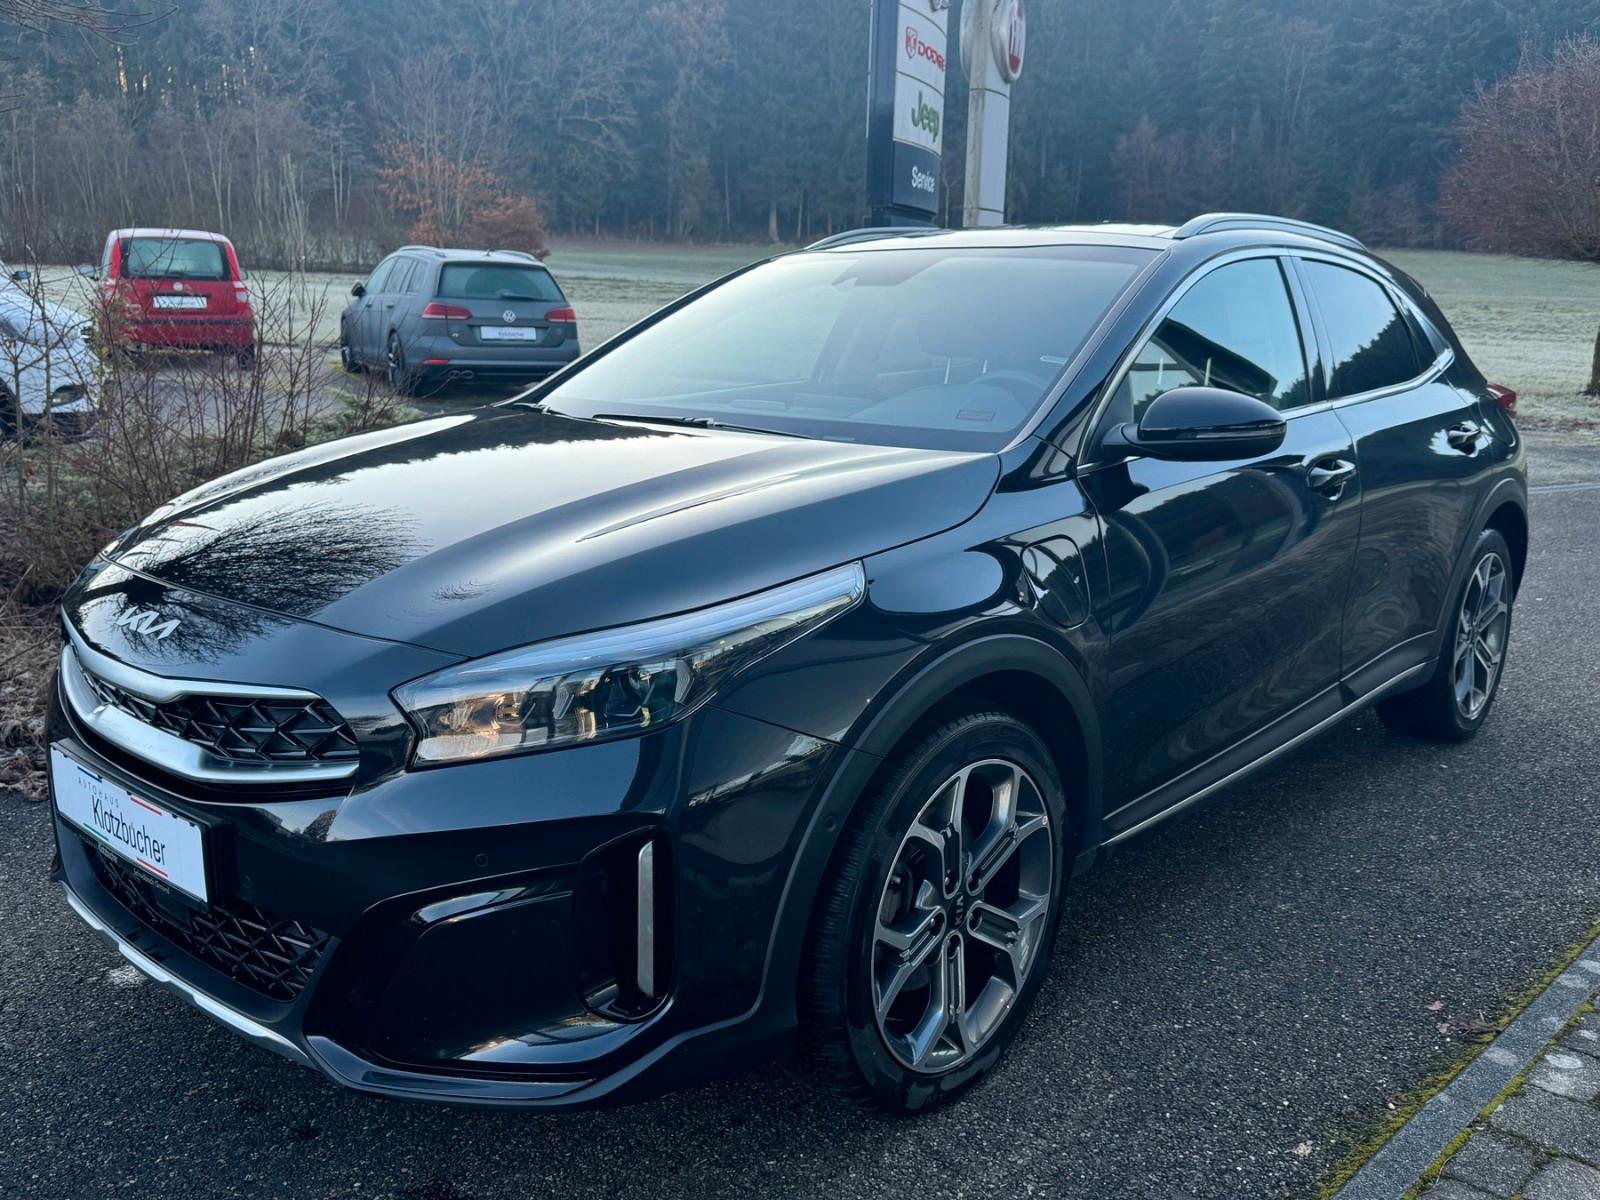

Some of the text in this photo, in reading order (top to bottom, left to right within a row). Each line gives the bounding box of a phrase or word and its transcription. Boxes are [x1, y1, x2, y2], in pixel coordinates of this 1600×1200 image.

[911, 91, 939, 143] Jeep
[911, 165, 935, 193] Service
[115, 605, 181, 641] KIA
[78, 777, 120, 809] AUTOHAUS
[91, 795, 166, 866] Klotzbücher
